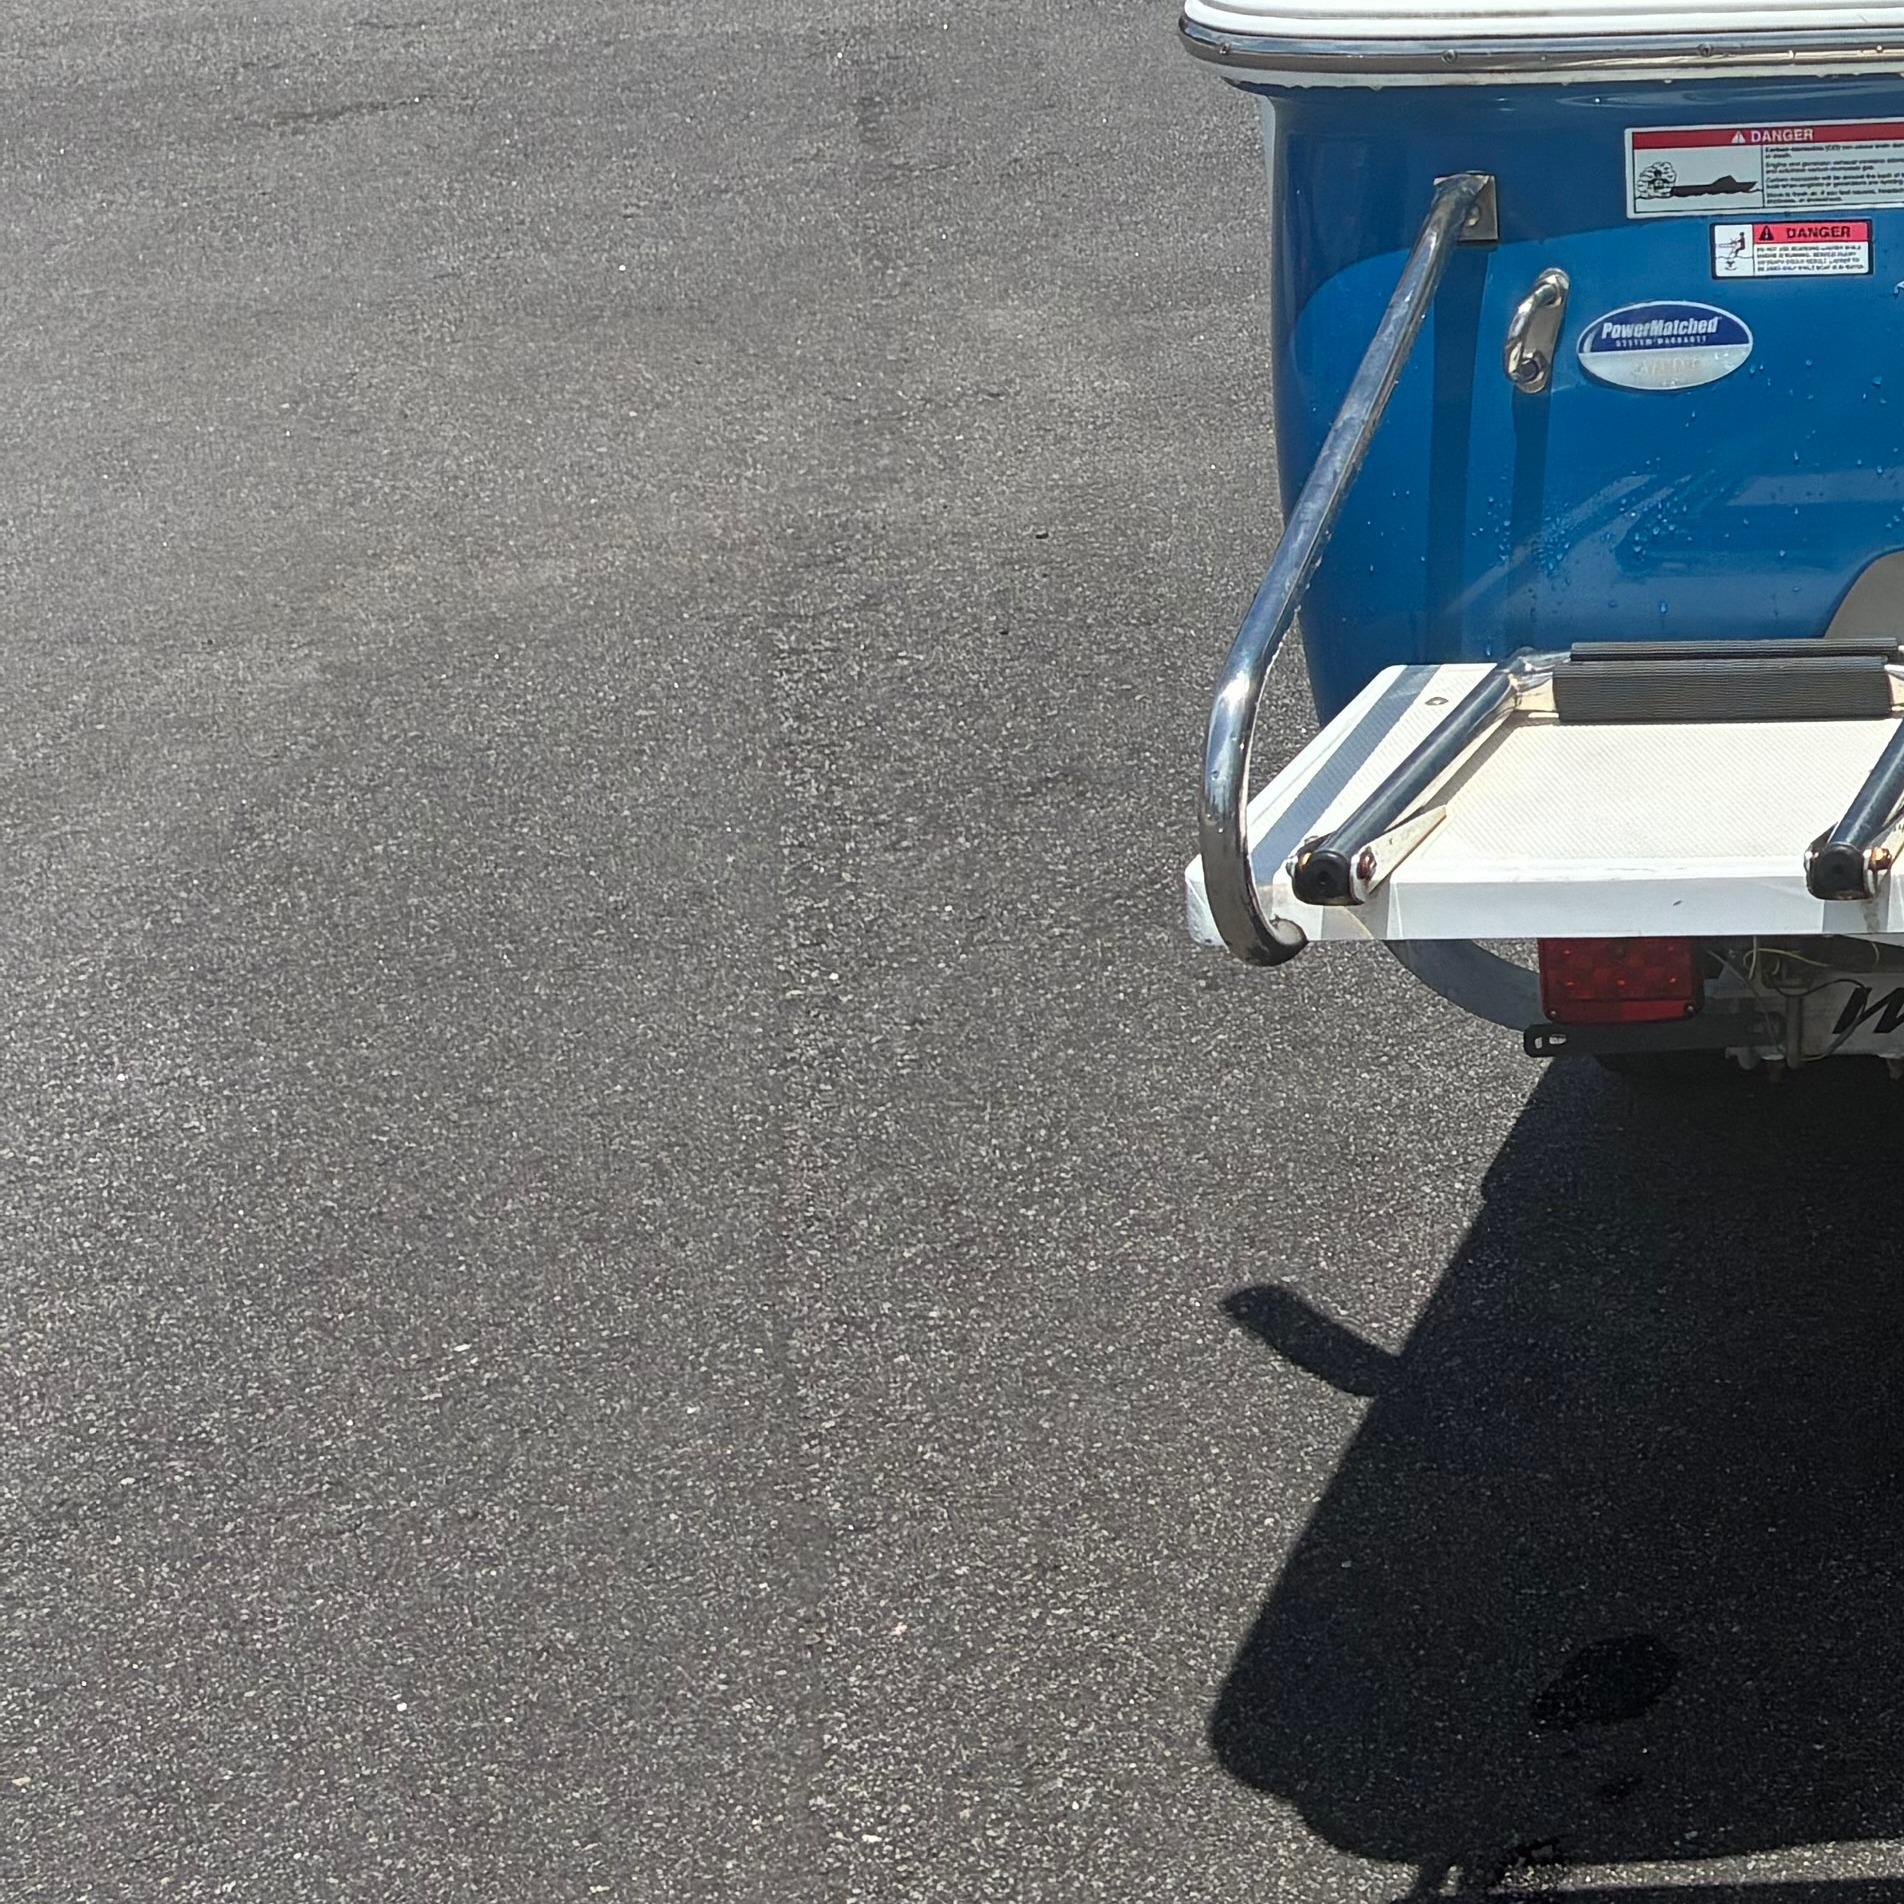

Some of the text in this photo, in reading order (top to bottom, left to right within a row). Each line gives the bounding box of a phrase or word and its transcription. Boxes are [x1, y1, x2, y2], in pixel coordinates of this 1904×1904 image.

[1750, 128, 1815, 143] DANGER
[1786, 225, 1851, 240] DANGER
[1601, 316, 1721, 340] PowerMatched
